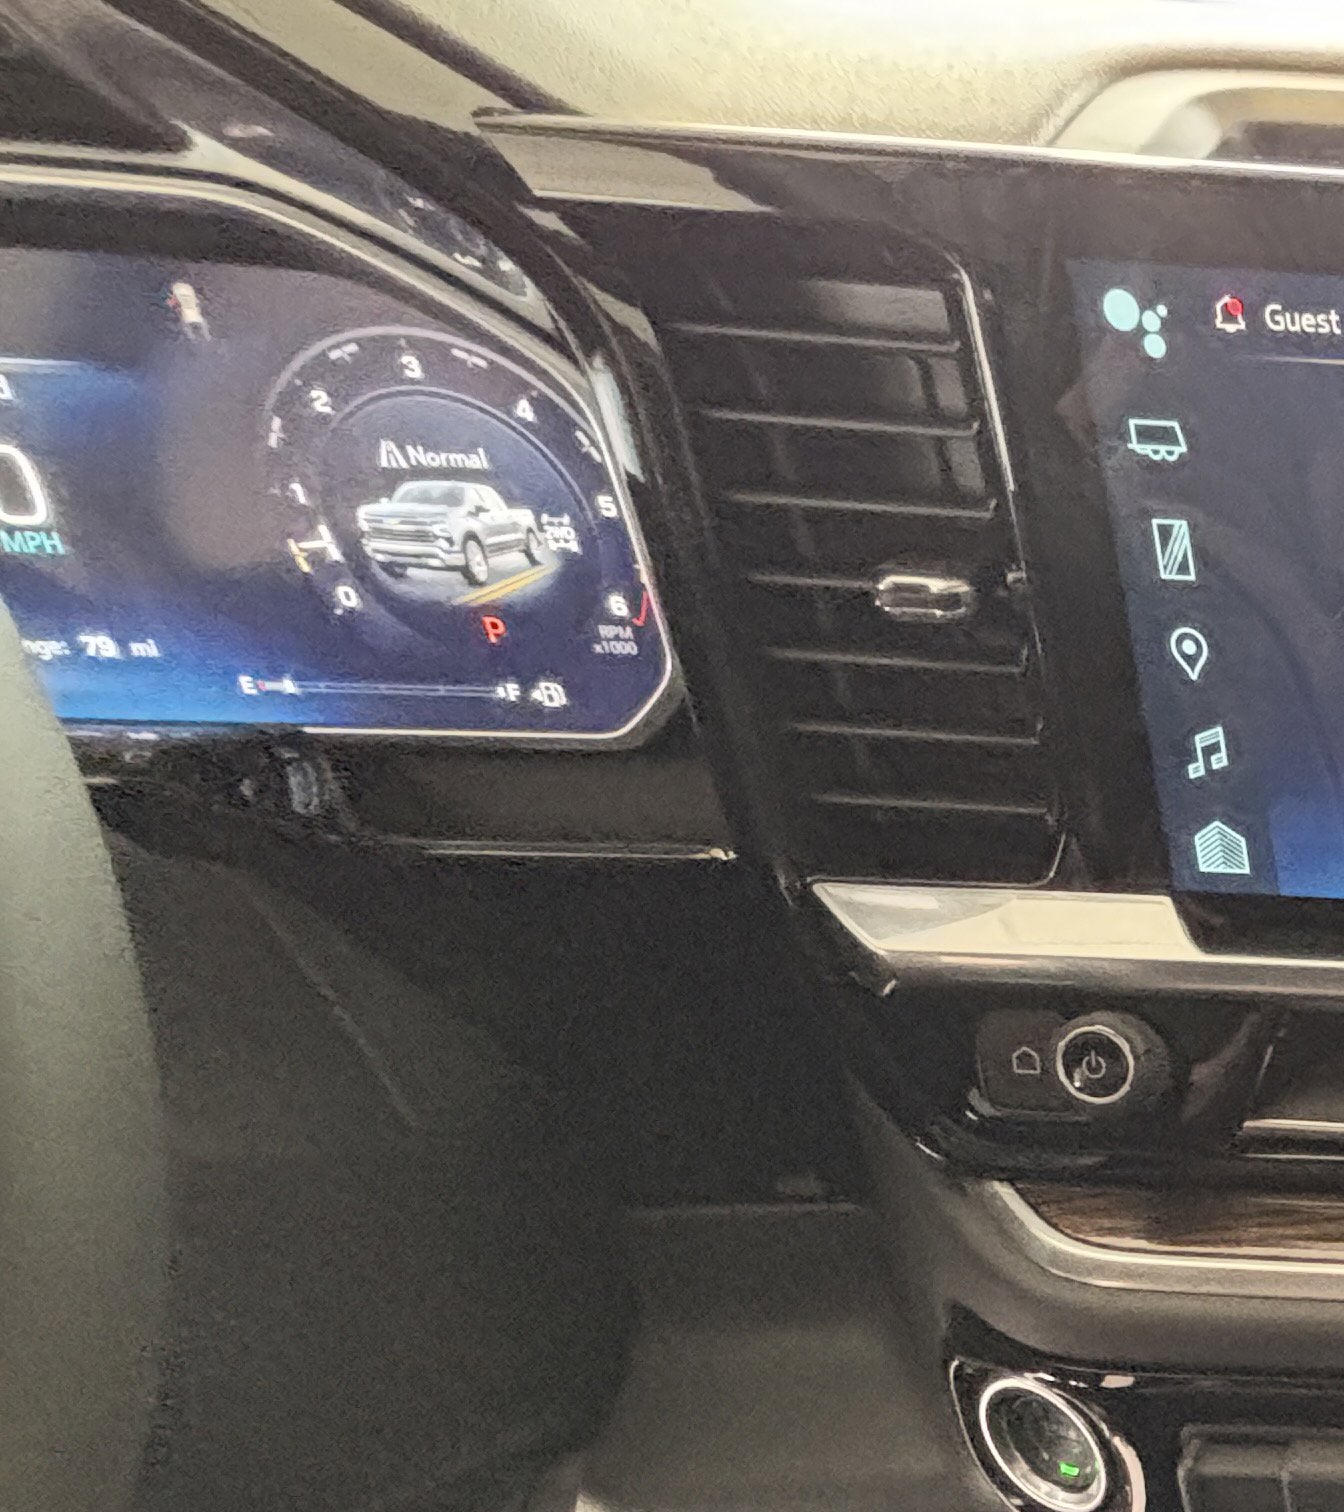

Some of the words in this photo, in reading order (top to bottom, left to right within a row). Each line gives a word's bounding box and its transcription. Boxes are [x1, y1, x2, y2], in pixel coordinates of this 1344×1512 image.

[1264, 303, 1342, 334] Guest
[400, 355, 423, 379] 3
[309, 389, 336, 415] 2
[515, 398, 538, 423] 4
[405, 445, 490, 470] Normal
[289, 482, 308, 506] 1
[597, 495, 618, 518] 5
[0, 530, 66, 555] MPH
[337, 585, 361, 608] 0
[608, 593, 630, 616] 6
[482, 615, 507, 644] P
[598, 625, 633, 639] RPM
[239, 676, 257, 694] E
[506, 683, 521, 701] F
